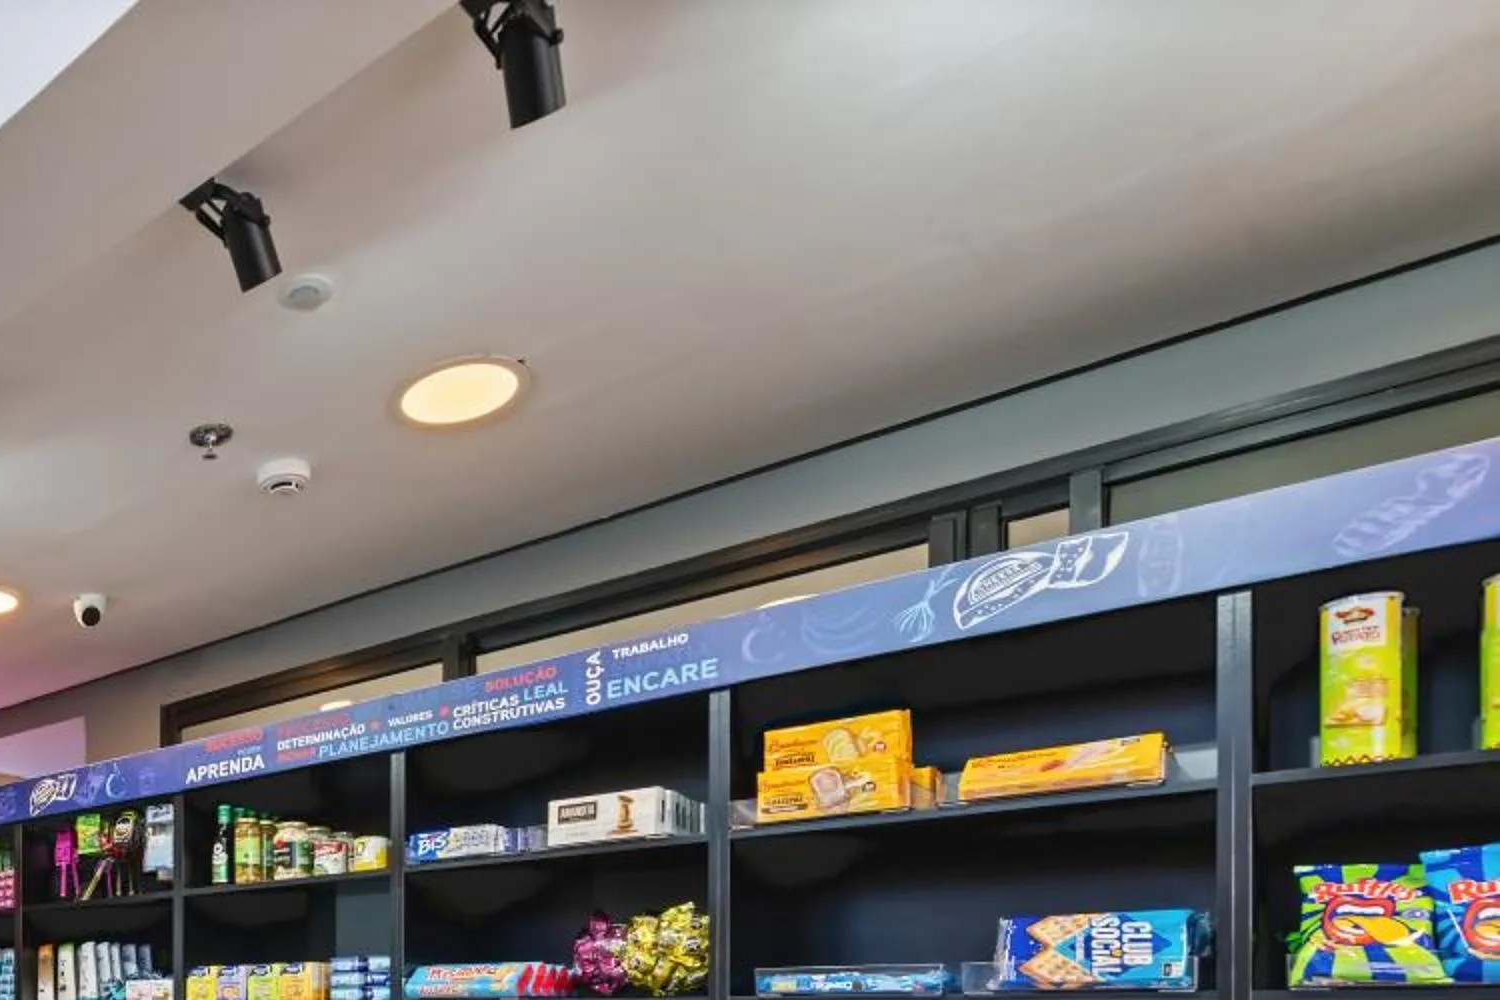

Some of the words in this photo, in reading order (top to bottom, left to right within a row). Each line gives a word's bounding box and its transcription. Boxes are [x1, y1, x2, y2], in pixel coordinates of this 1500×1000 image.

[612, 634, 688, 659] TRABALHO
[484, 667, 557, 692] SOLUÇÃO
[524, 680, 568, 701] LEAL
[586, 651, 604, 705] OUÇA
[607, 659, 719, 699] ENCARE
[388, 710, 432, 727] VALORES
[453, 694, 519, 718] CRÍTICAS
[453, 698, 565, 730] CONSTRUTIVAS
[277, 723, 365, 751] DETERMINAÇÃO
[319, 721, 448, 760] PLANEJAMENTO
[185, 754, 265, 785] APRENDA
[1092, 914, 1122, 974] SOCIAL
[1122, 921, 1152, 965] CLUB
